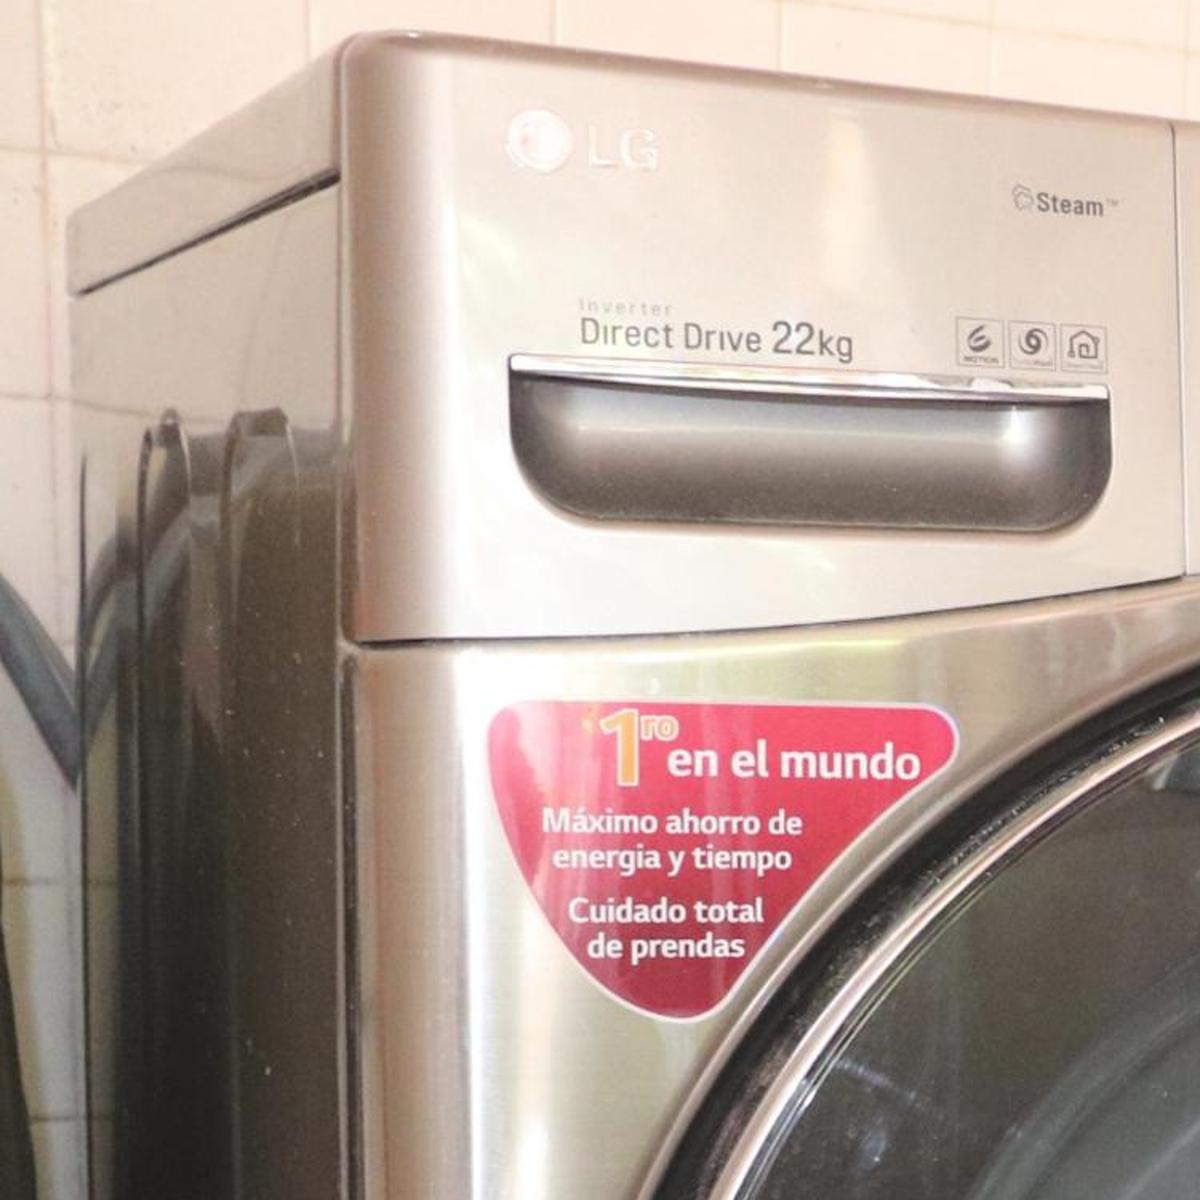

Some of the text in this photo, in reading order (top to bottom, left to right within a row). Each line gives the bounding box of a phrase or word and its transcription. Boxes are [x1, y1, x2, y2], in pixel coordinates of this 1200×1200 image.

[588, 123, 660, 172] LG
[581, 317, 853, 364] Direct Drive 22kg
[667, 748, 718, 778] en
[731, 738, 769, 778] el
[781, 741, 920, 780] mundo
[542, 807, 802, 835] Máximo ahorro de
[668, 850, 684, 877] y
[692, 844, 792, 878] tiempo
[568, 896, 765, 923] Cuidado total
[587, 932, 746, 966] de prendas
